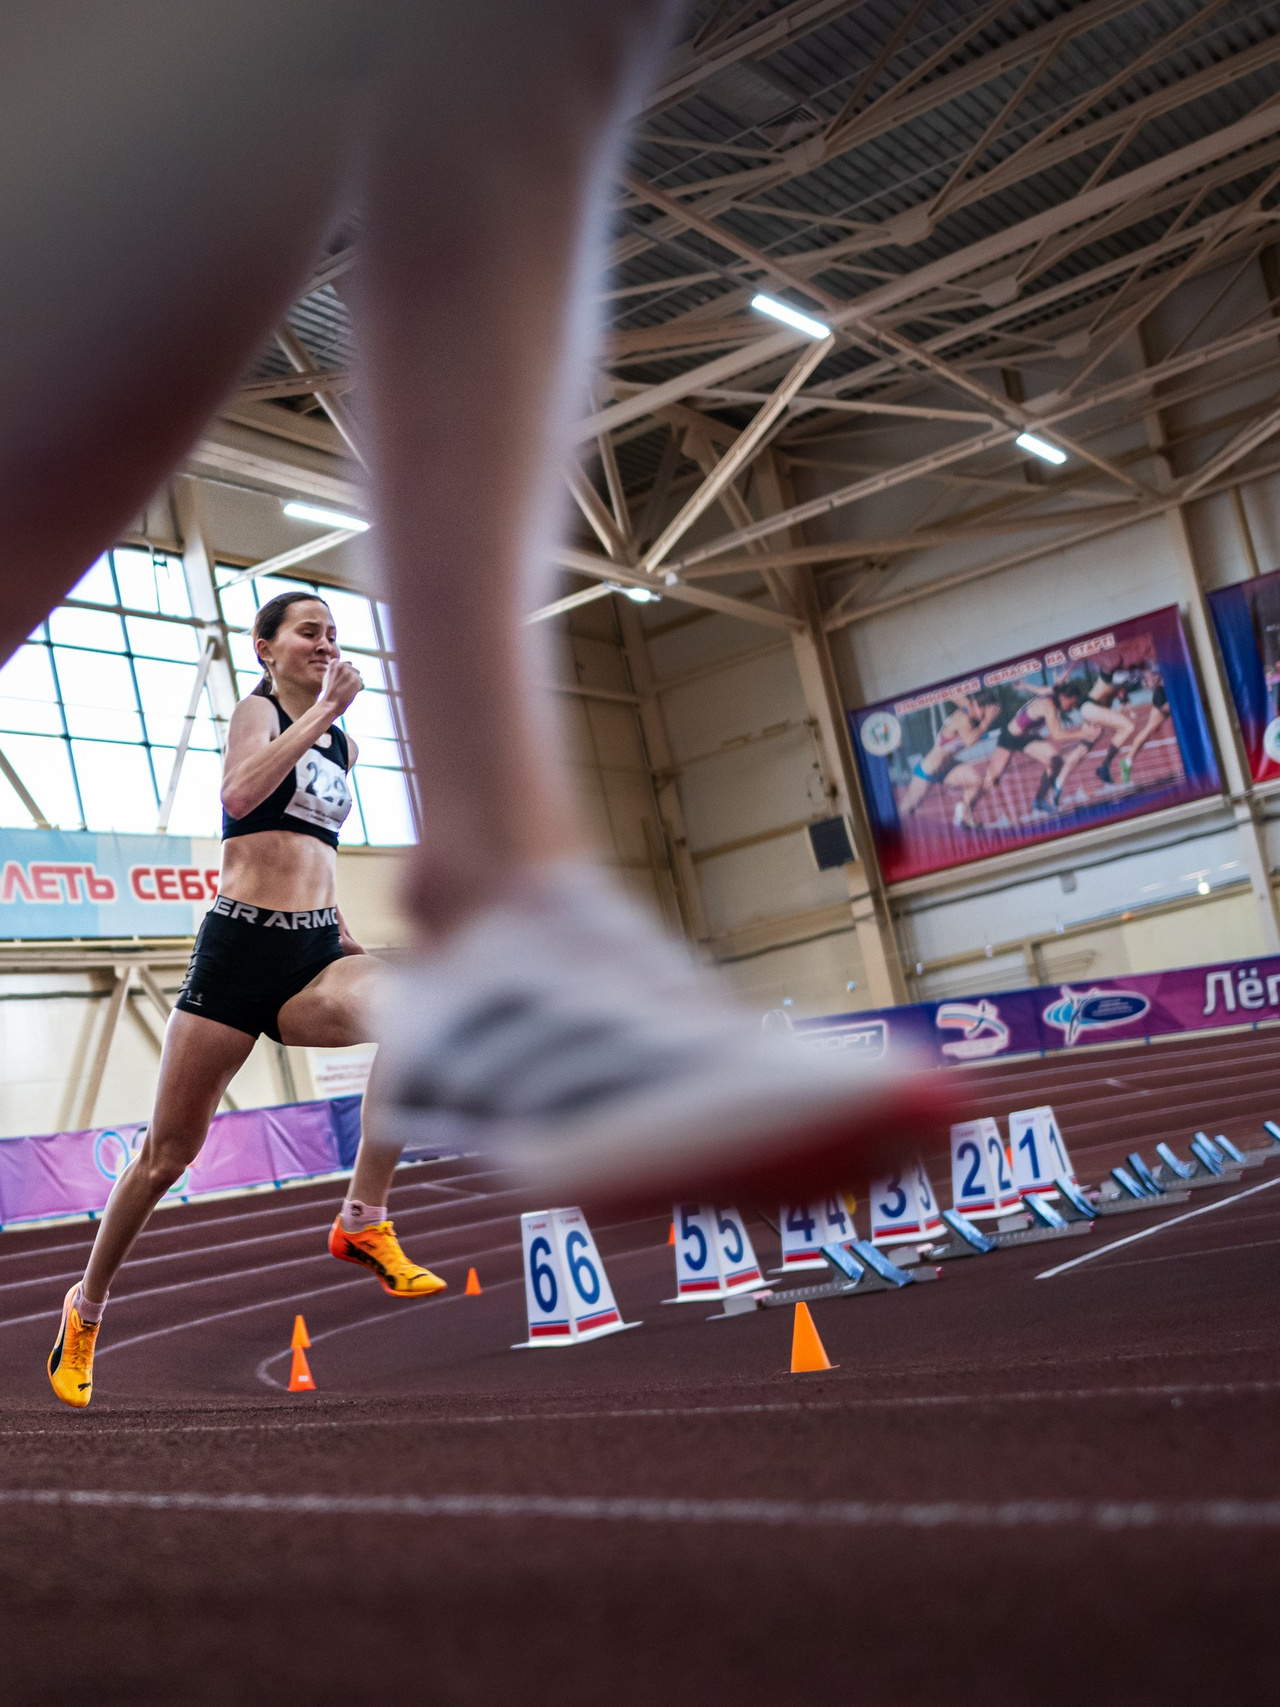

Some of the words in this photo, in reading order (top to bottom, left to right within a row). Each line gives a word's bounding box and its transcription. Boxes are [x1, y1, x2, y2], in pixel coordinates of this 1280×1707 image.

[957, 1141, 986, 1197] 2
[988, 1137, 1012, 1191] 2
[1018, 1126, 1041, 1180] 1
[1049, 1123, 1067, 1173] 1
[786, 1200, 816, 1242] 4
[825, 1195, 847, 1235] 4
[879, 1171, 907, 1218] 3
[680, 1203, 708, 1271] 5
[716, 1205, 744, 1264] 5
[529, 1236, 558, 1313] 6
[565, 1229, 600, 1305] 6
